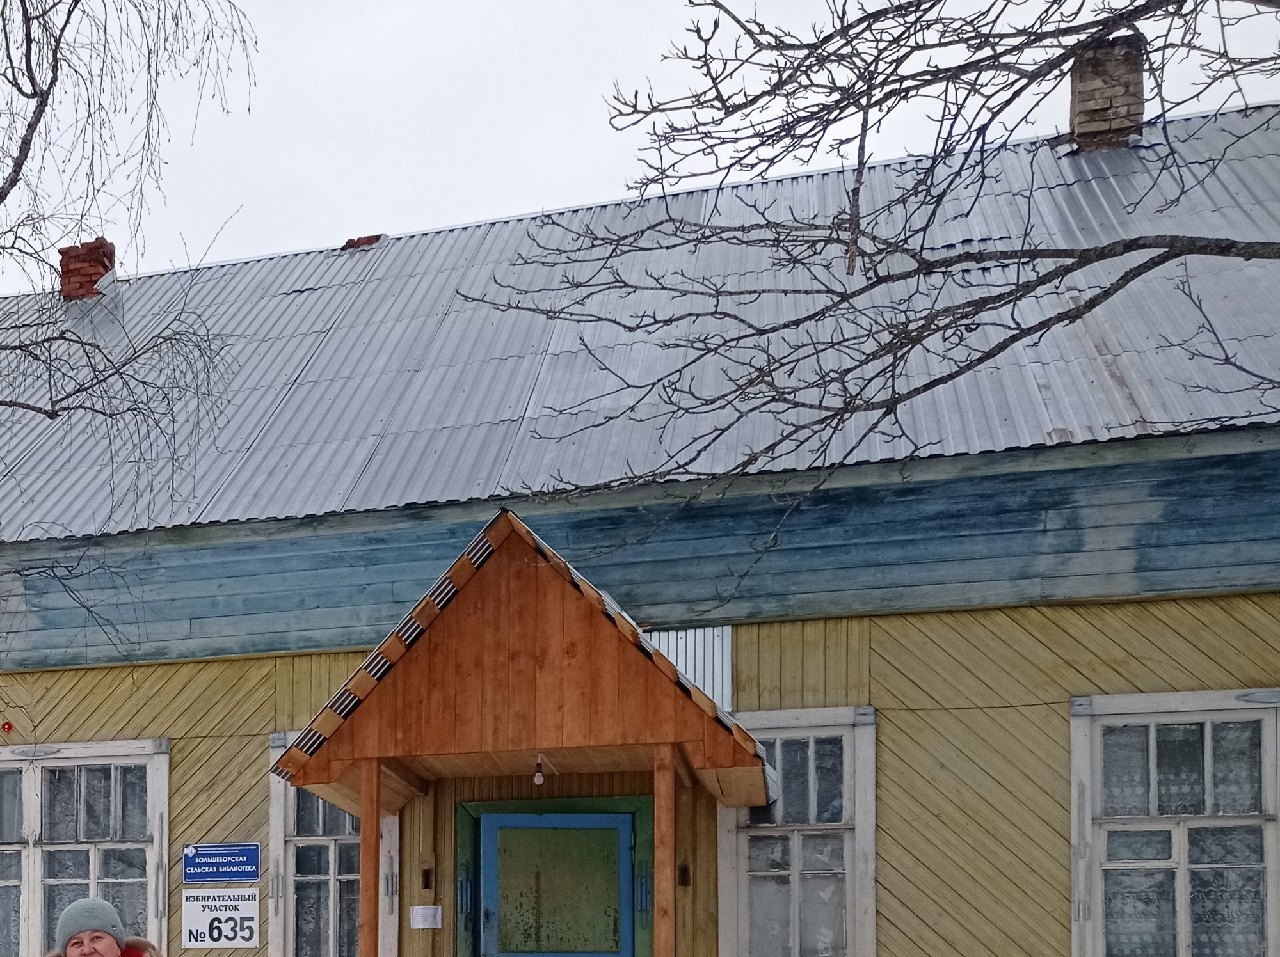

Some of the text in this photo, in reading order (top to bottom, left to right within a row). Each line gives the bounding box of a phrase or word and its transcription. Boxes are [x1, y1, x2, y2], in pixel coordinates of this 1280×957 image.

[185, 893, 256, 902] ИЗБИРАТЕЛЬНЫЙ
[201, 904, 240, 912] УЧАСТОК
[209, 917, 254, 942] 635
